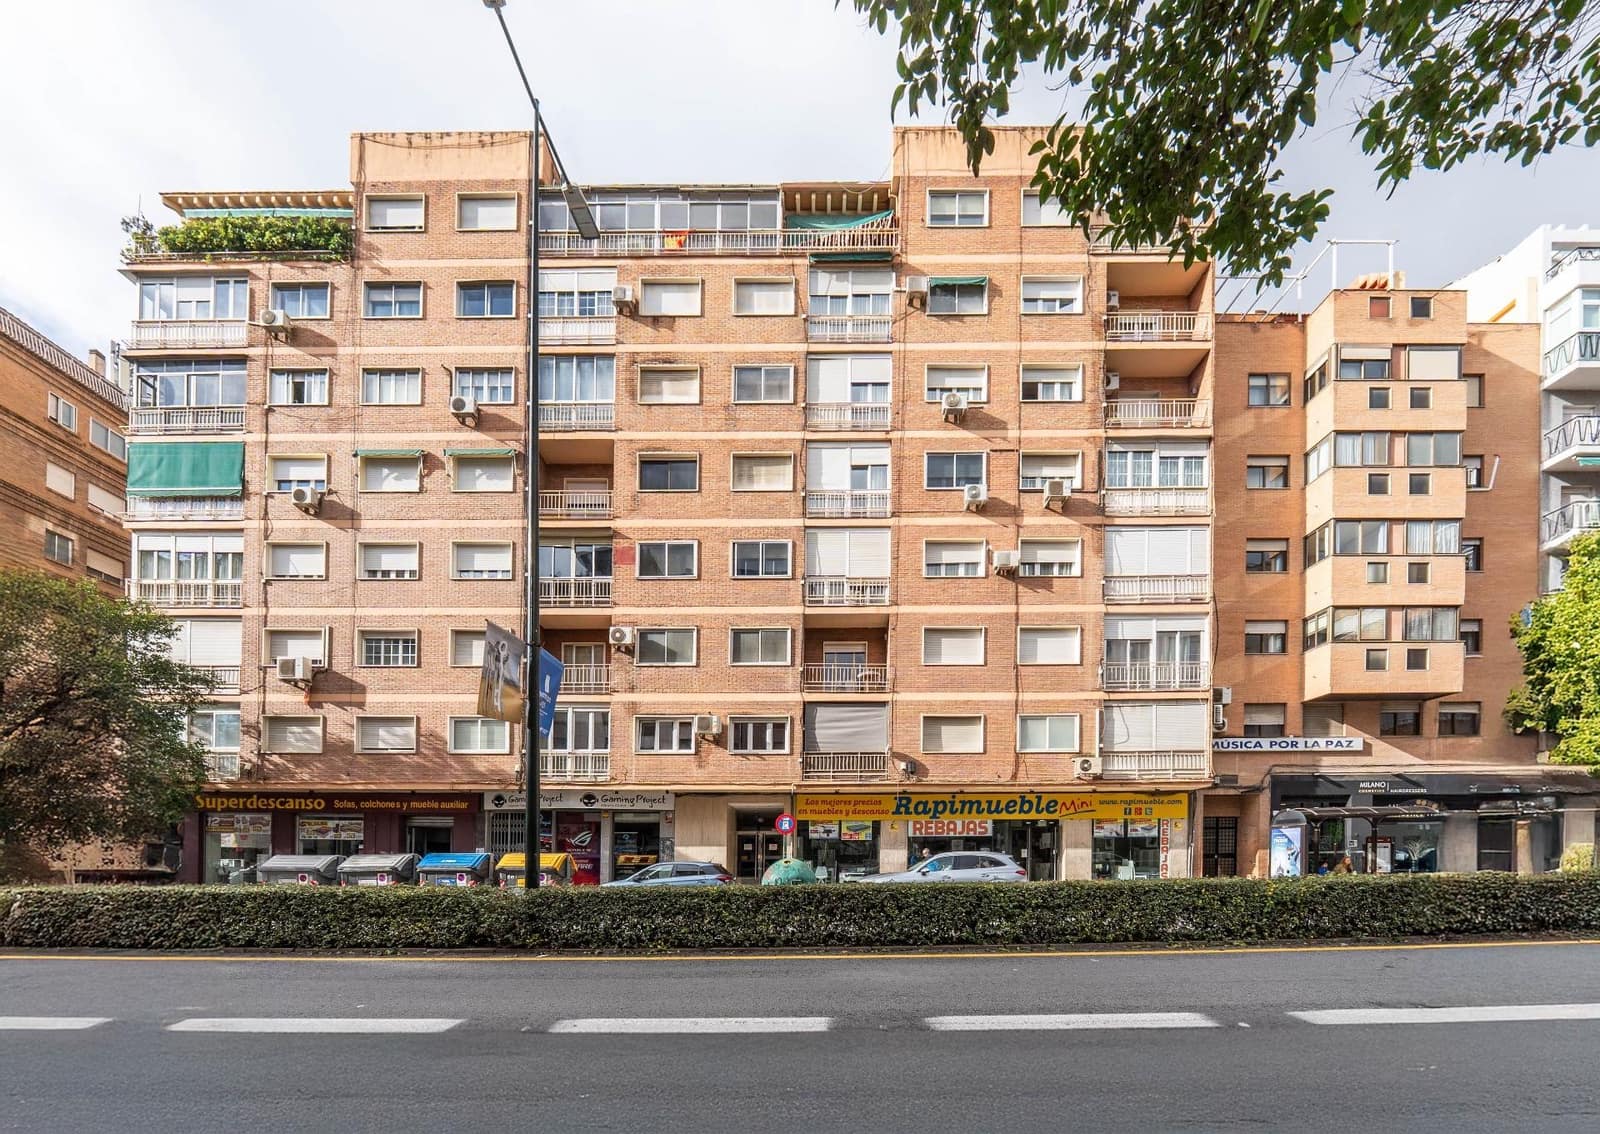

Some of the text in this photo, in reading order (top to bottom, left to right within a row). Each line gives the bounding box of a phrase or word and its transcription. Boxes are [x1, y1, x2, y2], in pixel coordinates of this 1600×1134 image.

[1269, 739, 1299, 749] POR
[1304, 739, 1321, 749] LA
[1325, 739, 1354, 749] PAZ
[196, 794, 325, 811] Superdescanso
[360, 799, 400, 809] colchones
[403, 801, 407, 810] y
[410, 799, 439, 809] mueble
[440, 799, 469, 809] auxiliar
[601, 794, 666, 809] Gaming Project
[820, 798, 851, 807] mejores
[852, 798, 882, 807] precios
[892, 794, 1058, 819] Rapimueble
[1059, 795, 1093, 814] Mini
[1099, 798, 1183, 806] www.rapimueble.com
[809, 807, 843, 815] muebles
[844, 809, 850, 817] y
[851, 807, 890, 815] descanso
[912, 819, 989, 836] REBAJAS
